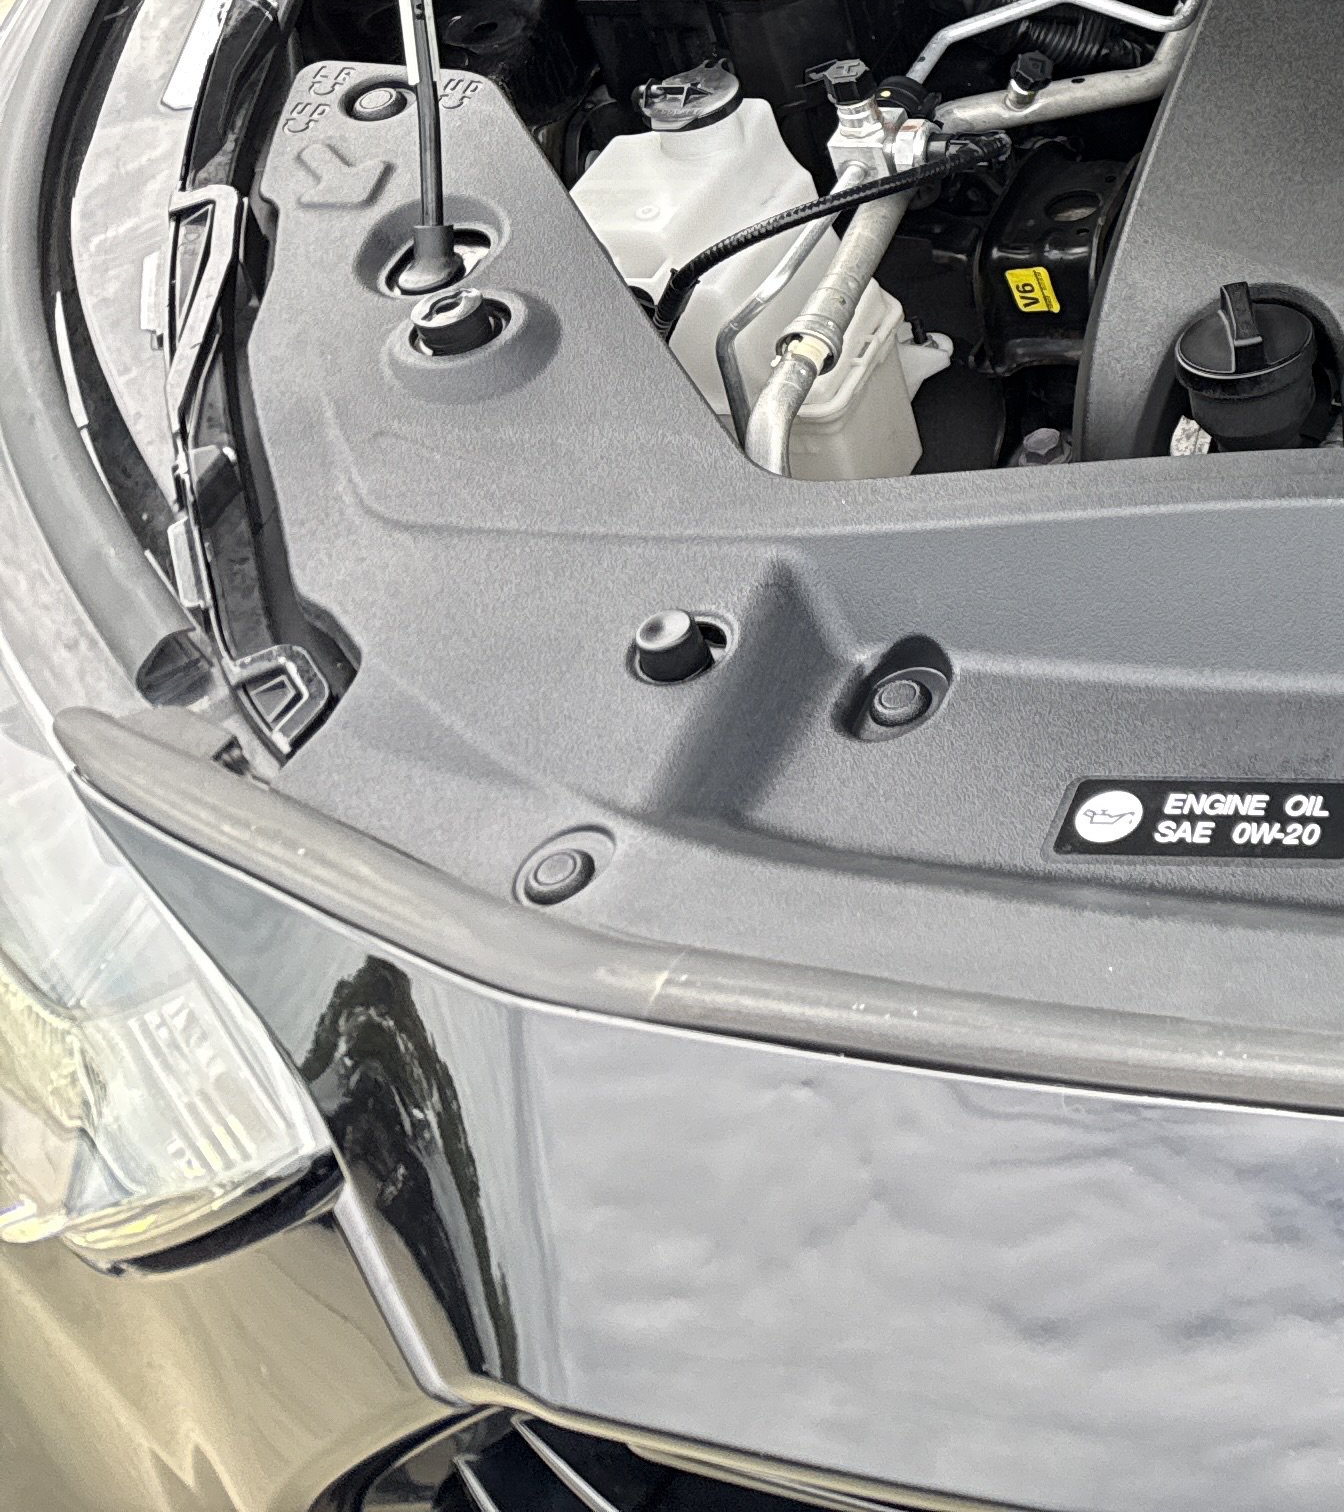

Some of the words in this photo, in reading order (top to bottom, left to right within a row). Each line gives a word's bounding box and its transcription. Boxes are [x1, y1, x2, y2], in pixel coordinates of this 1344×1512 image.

[1016, 282, 1040, 309] V6
[1164, 793, 1270, 816] ENGINE
[1284, 794, 1330, 817] OIL
[1153, 821, 1215, 844] SAE
[1231, 822, 1321, 846] 0W-20
